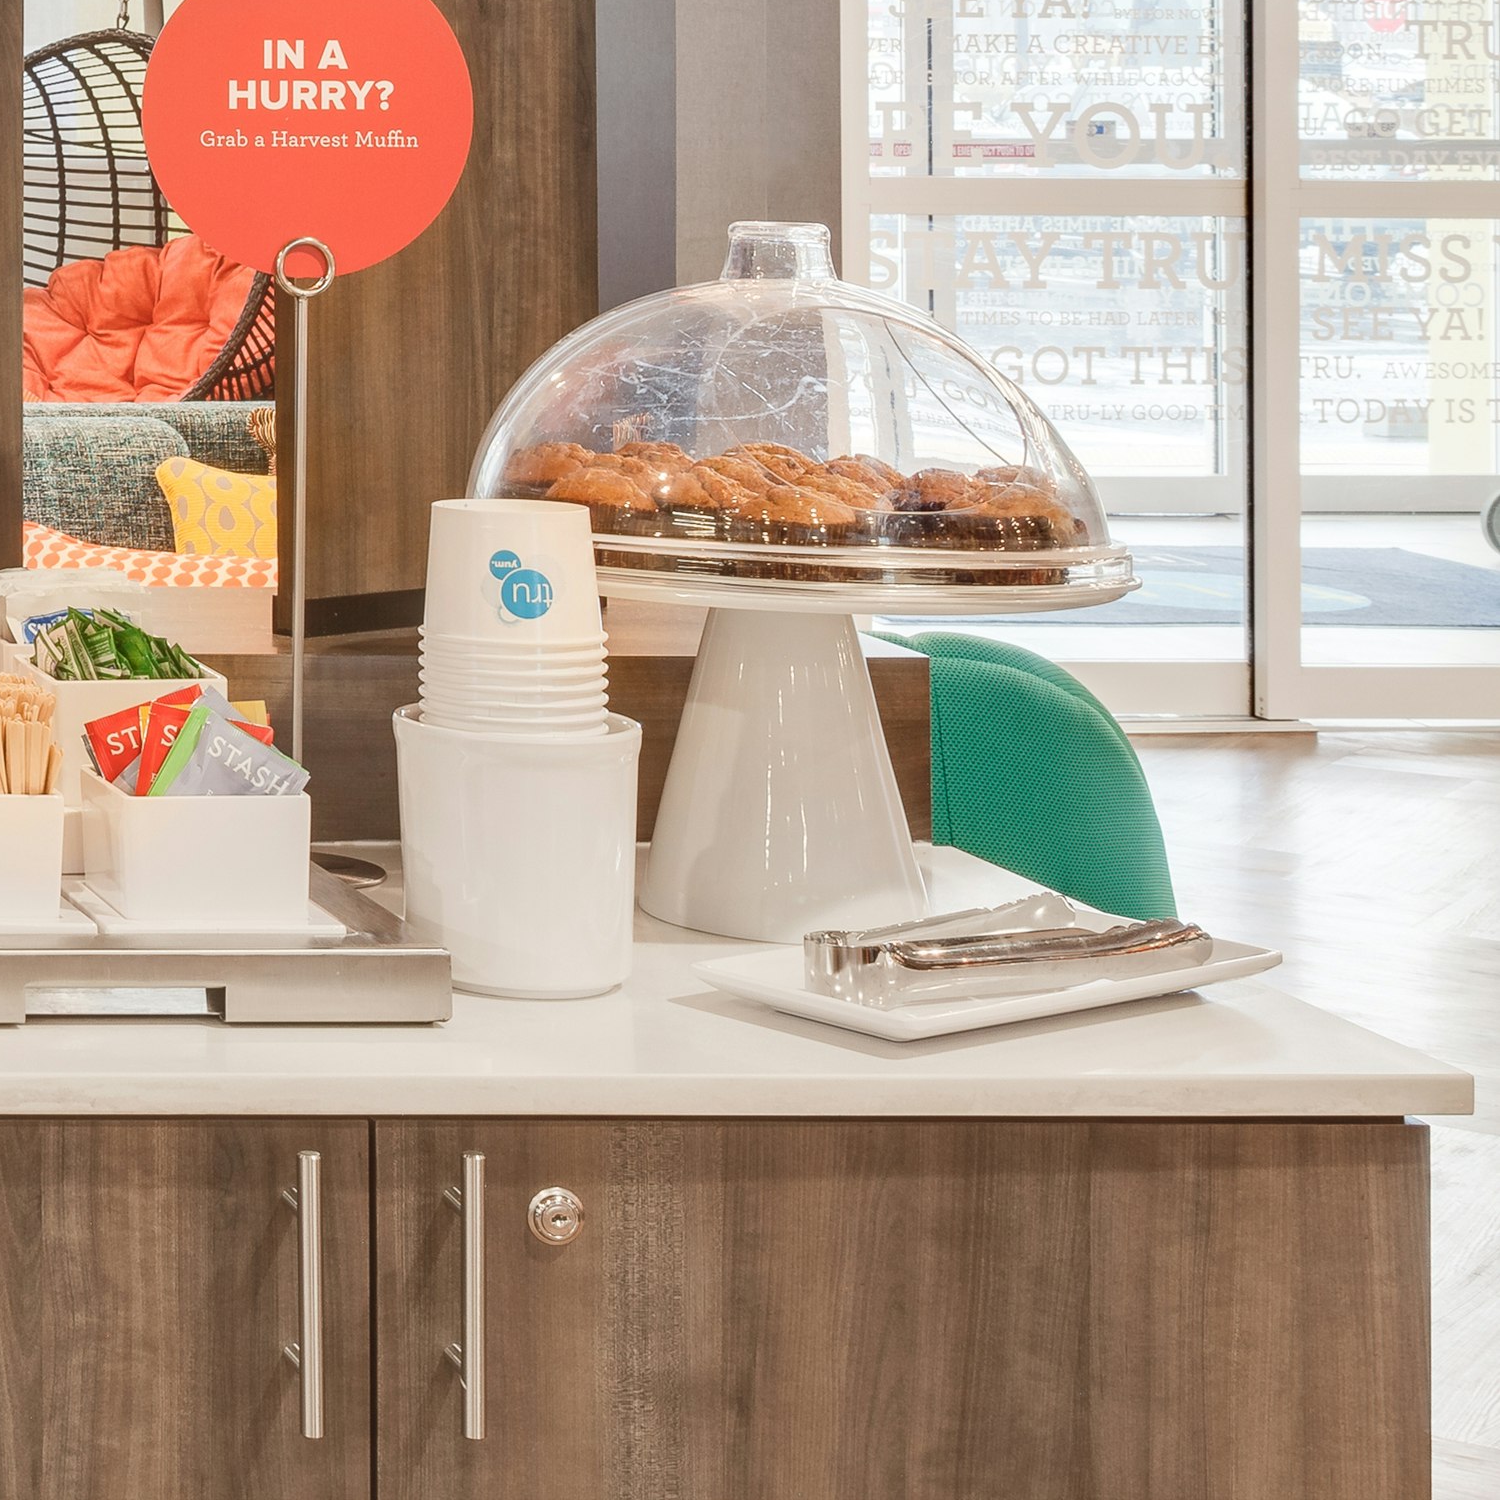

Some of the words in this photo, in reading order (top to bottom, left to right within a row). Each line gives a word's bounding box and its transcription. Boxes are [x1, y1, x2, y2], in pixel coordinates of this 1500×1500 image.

[1146, 8, 1176, 20] FOR
[263, 39, 305, 70] IN
[317, 39, 349, 70] A
[1026, 34, 1046, 54] A
[1053, 34, 1189, 55] CREATIVE
[1000, 71, 1064, 86] AFTER
[1425, 78, 1486, 93] TIMES
[227, 80, 394, 111] HURRY?
[1010, 100, 1232, 171] YOU.
[1343, 107, 1401, 139] GO
[1415, 108, 1492, 138] GET
[200, 130, 248, 149] Grab
[254, 134, 265, 149] a
[270, 130, 349, 149] Harvest
[355, 130, 419, 150] Muffin
[1310, 150, 1381, 172] BEST
[1388, 150, 1449, 172] DAY
[864, 230, 1061, 290] STAY
[1312, 233, 1472, 284] MISS
[961, 311, 1021, 326] TIMES
[1028, 311, 1054, 326] TO
[1060, 311, 1082, 326] BE
[1087, 311, 1131, 326] HAD
[1312, 307, 1394, 341] SEE
[1409, 307, 1485, 341] YA!
[990, 345, 1105, 386] GOT
[1121, 345, 1247, 386] THIS
[1048, 405, 1127, 421] TRU-LY
[1131, 405, 1198, 421] GOOD
[1312, 398, 1435, 424] TODAY
[1445, 398, 1476, 424] IS
[513, 582, 553, 609] tru
[207, 735, 290, 796] STASH
